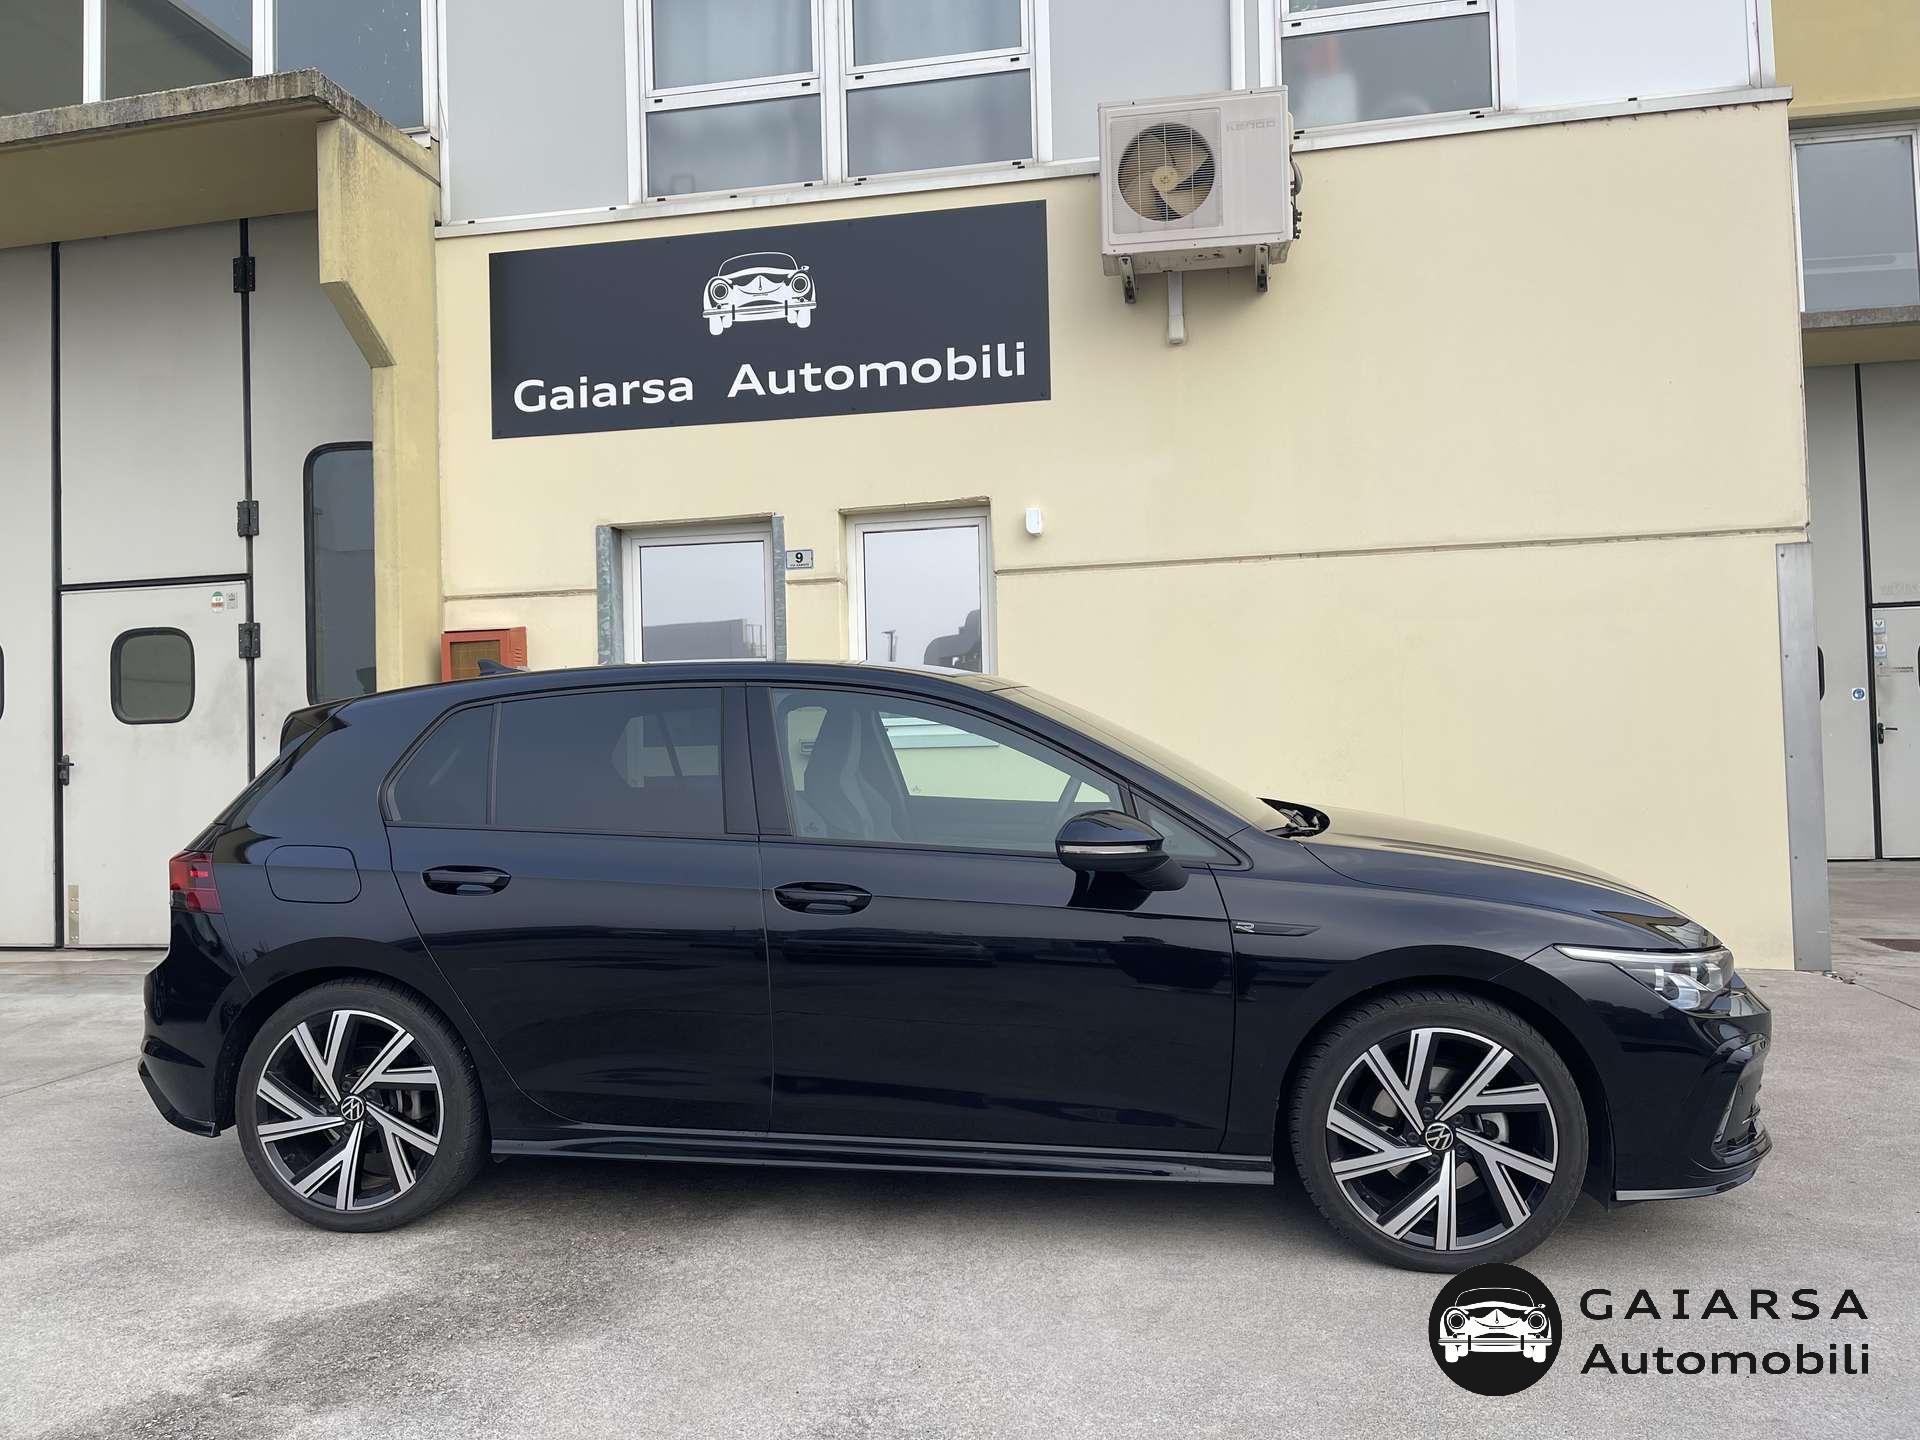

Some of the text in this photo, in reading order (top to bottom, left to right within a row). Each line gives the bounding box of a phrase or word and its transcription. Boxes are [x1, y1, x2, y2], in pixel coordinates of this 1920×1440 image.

[513, 341, 1027, 413] Gaiarsa Automobili
[795, 551, 804, 564] 9
